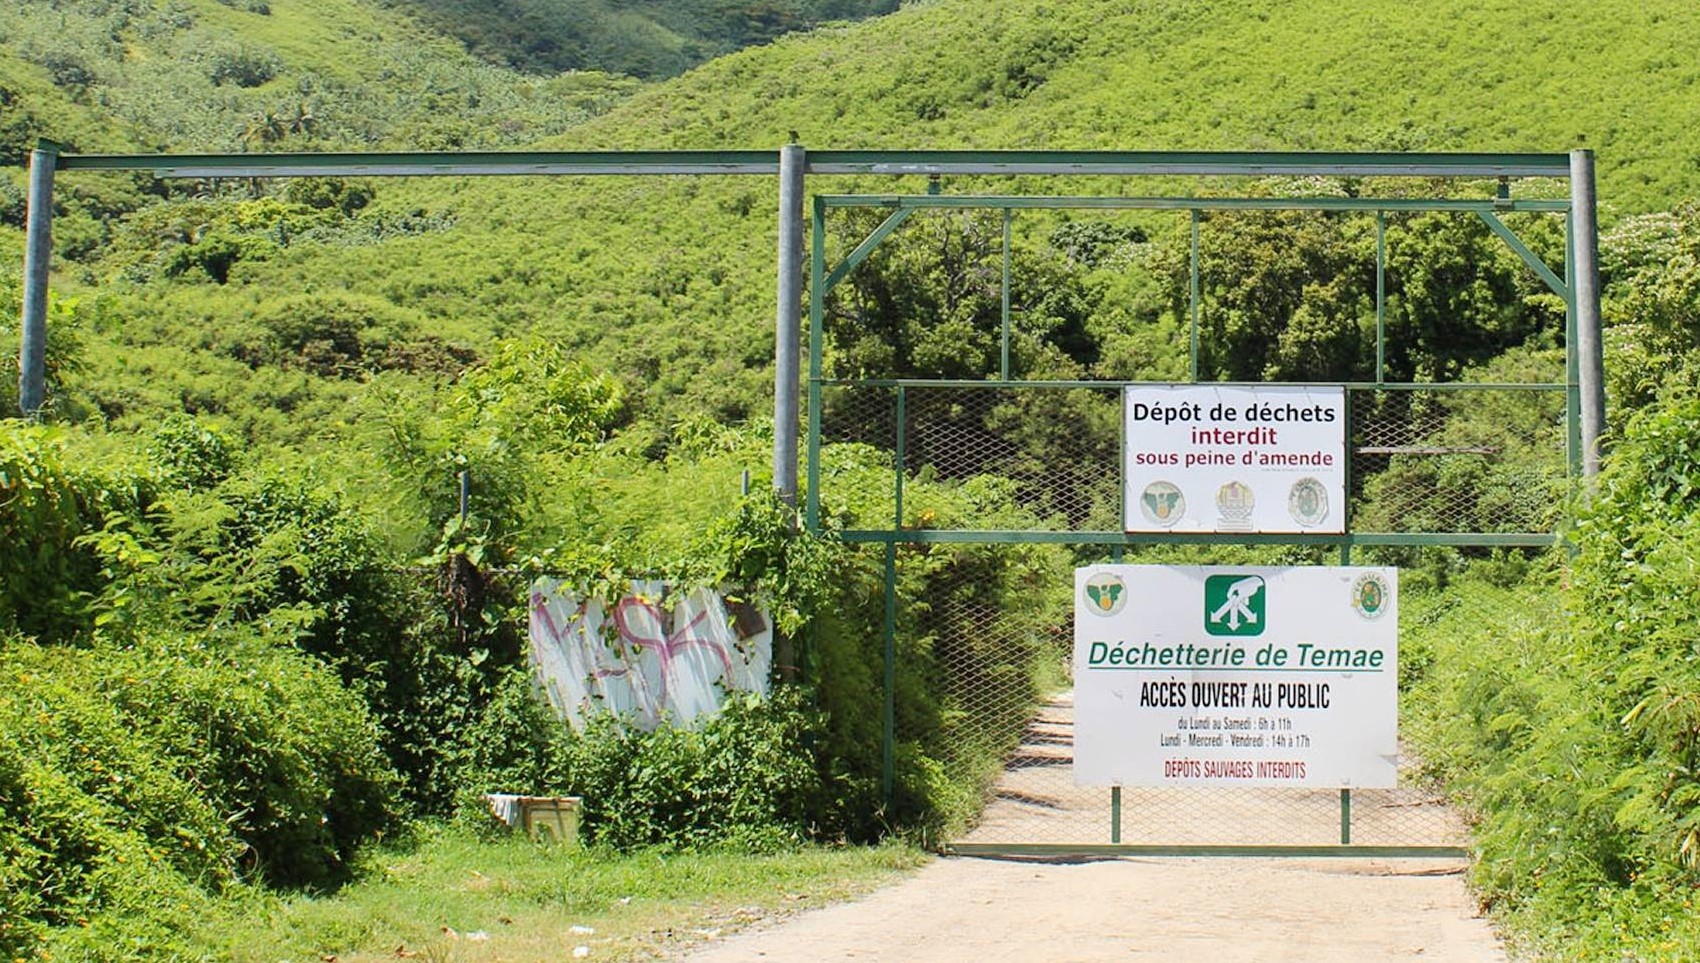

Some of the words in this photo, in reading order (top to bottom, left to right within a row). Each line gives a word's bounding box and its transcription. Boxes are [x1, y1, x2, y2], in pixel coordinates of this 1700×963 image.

[1134, 401, 1202, 425] Dépôt
[1210, 402, 1237, 422] de
[1245, 402, 1336, 422] déchets
[1192, 426, 1278, 445] interdit
[1136, 453, 1179, 465] sous
[1186, 450, 1236, 468] peine
[1242, 451, 1334, 466] d'amende
[1088, 640, 1246, 666] Déchetterie
[1256, 643, 1288, 667] de
[1298, 643, 1384, 667] Temae
[1140, 676, 1187, 708] ACCÈS
[1192, 682, 1248, 708] OUVERT
[1252, 683, 1273, 709] AU
[1278, 684, 1330, 709] PUBLIC
[1178, 717, 1188, 730] du
[1190, 717, 1210, 730] Lundi
[1212, 719, 1223, 730] au
[1224, 717, 1251, 730] Samedi
[1258, 718, 1268, 730] 6h
[1278, 718, 1292, 730] 11h
[1160, 734, 1181, 747] Lundi
[1189, 734, 1224, 747] Mercredi
[1231, 734, 1264, 748] Vendredi
[1272, 735, 1286, 748] 14h
[1296, 735, 1310, 748] 17h
[1164, 757, 1201, 779] DÉPÔTS
[1204, 760, 1254, 779] SAUVAGES
[1257, 761, 1306, 779] INTERDITS
